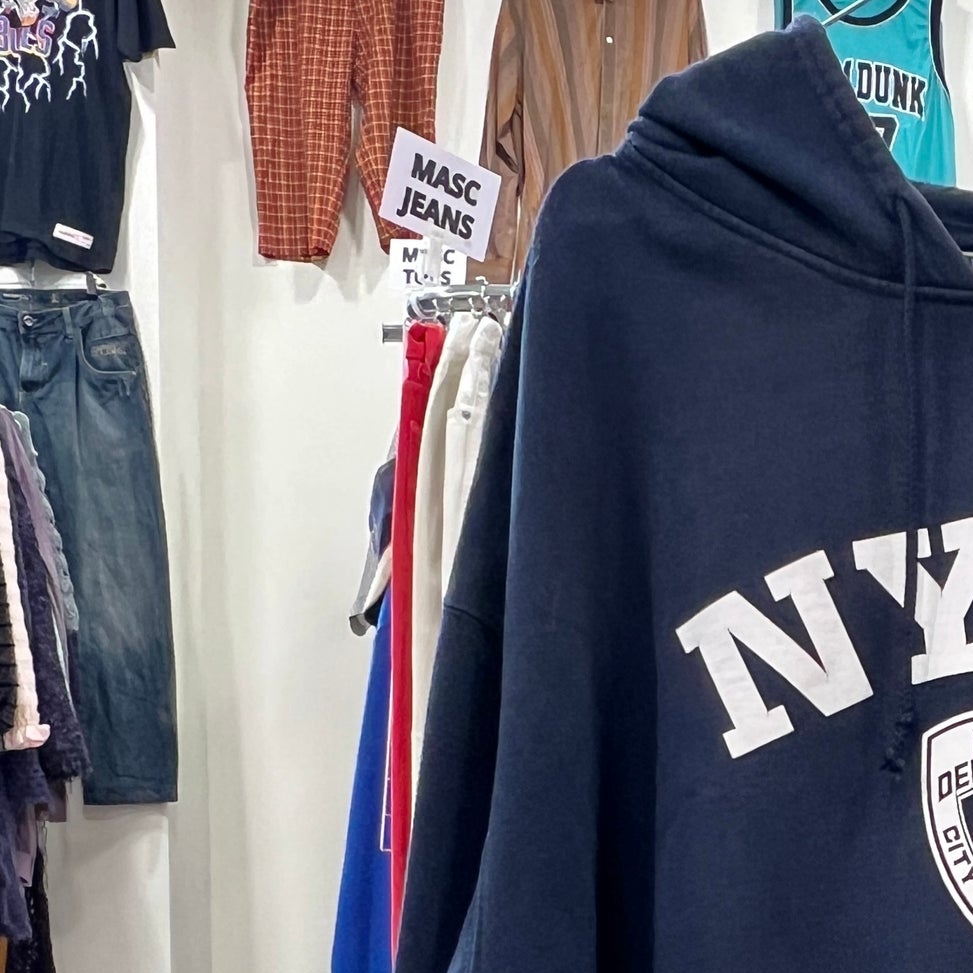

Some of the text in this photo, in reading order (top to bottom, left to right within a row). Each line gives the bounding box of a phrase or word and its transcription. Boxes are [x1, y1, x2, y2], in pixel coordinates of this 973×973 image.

[411, 152, 482, 207] MASC
[396, 186, 475, 240] JEANS
[402, 246, 455, 265] MC
[402, 268, 452, 286] TS
